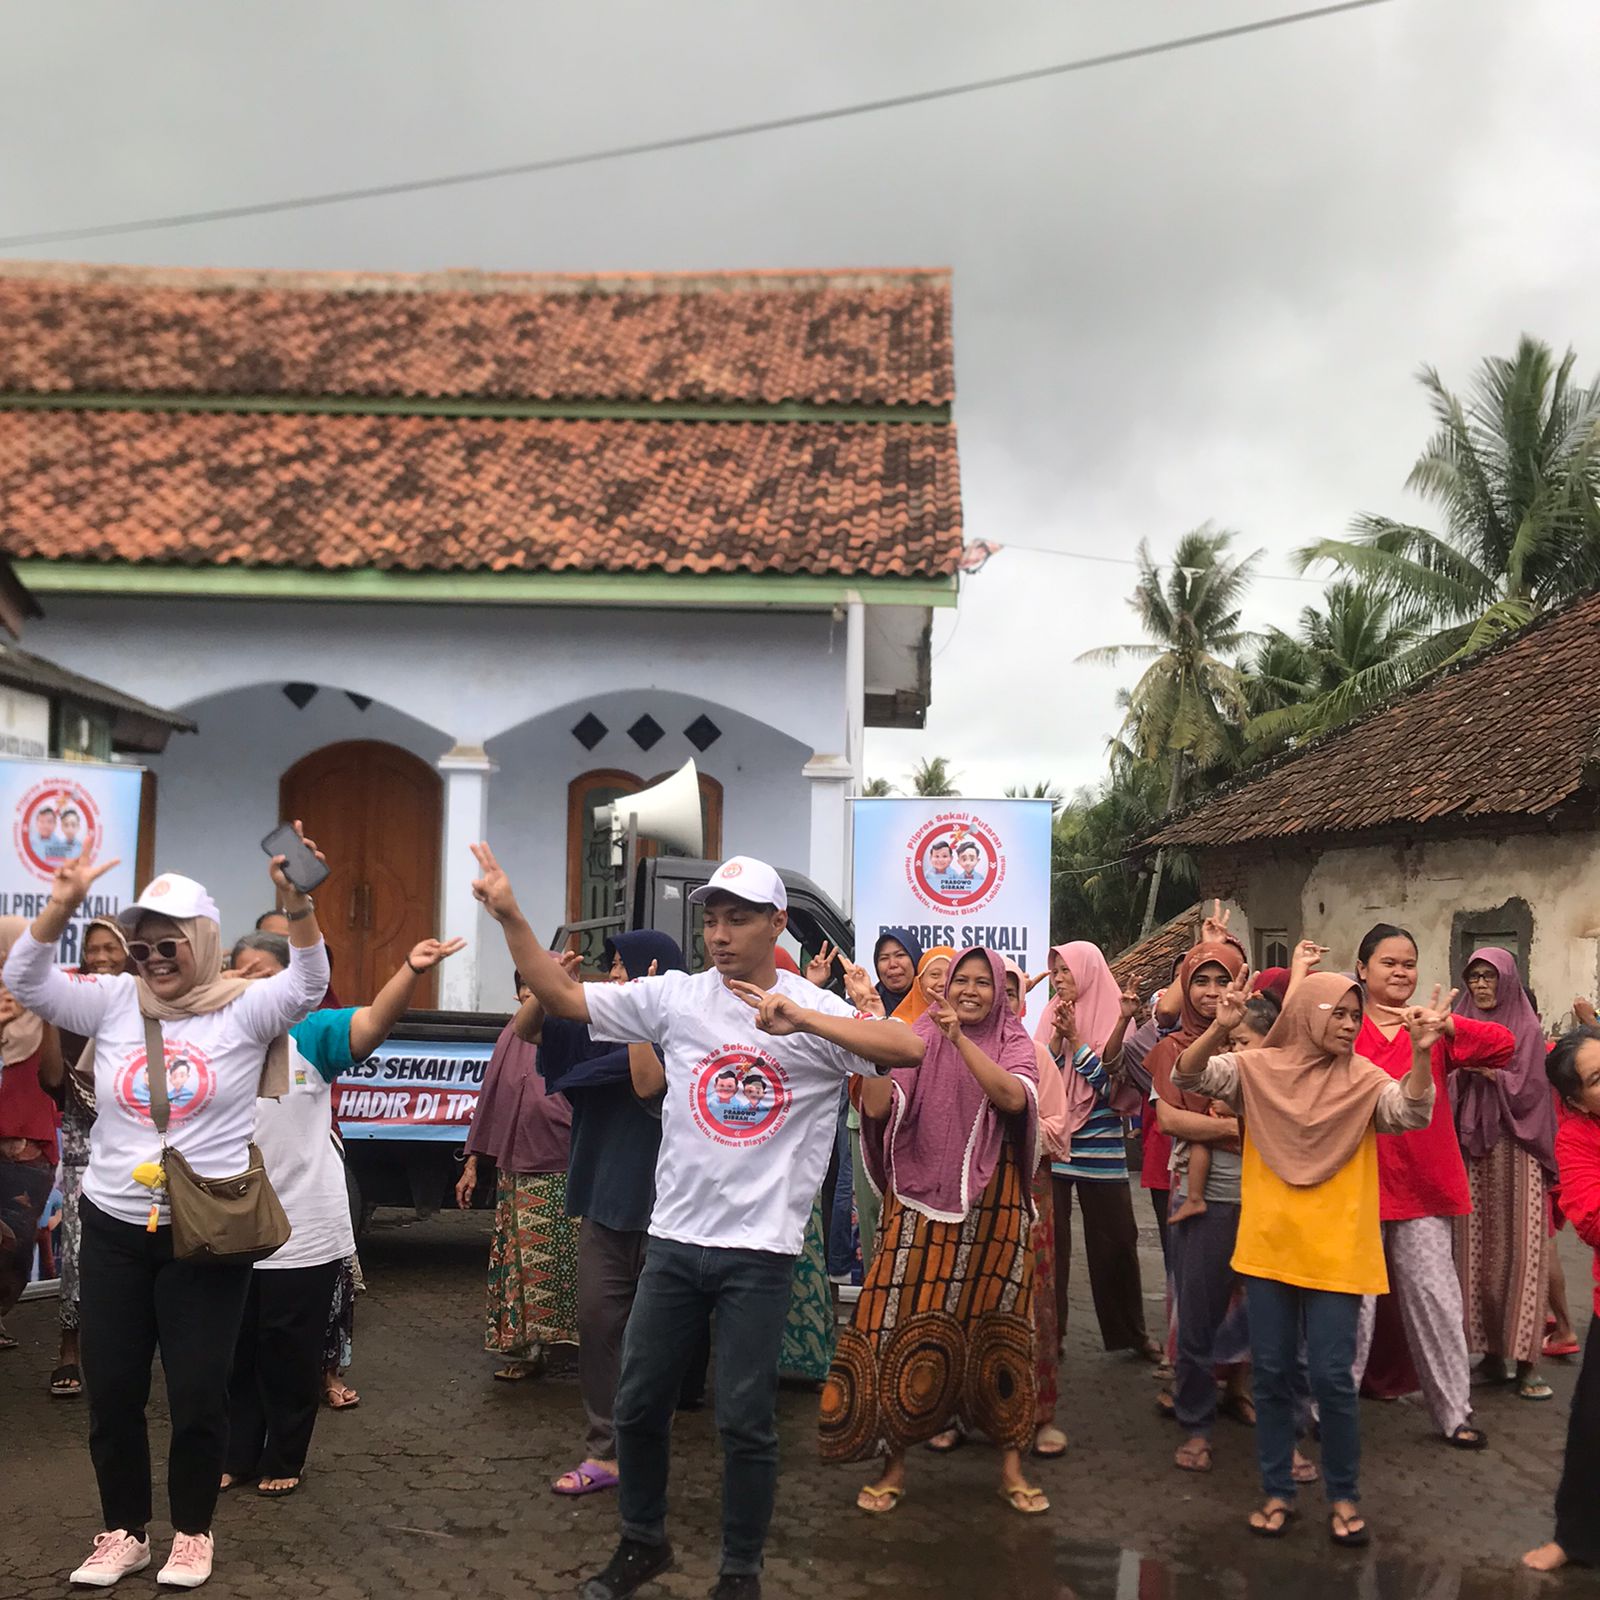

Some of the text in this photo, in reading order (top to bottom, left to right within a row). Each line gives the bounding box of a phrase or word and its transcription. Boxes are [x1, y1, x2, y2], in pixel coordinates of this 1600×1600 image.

[906, 812, 1003, 849] Pilpres Sekali Putaran
[961, 926, 1027, 951] SEKALI
[384, 1057, 456, 1081] SEKALI
[692, 1043, 790, 1083] Pilpres Sekali Putaran
[336, 1090, 411, 1119] HADIR
[413, 1092, 441, 1120] DI
